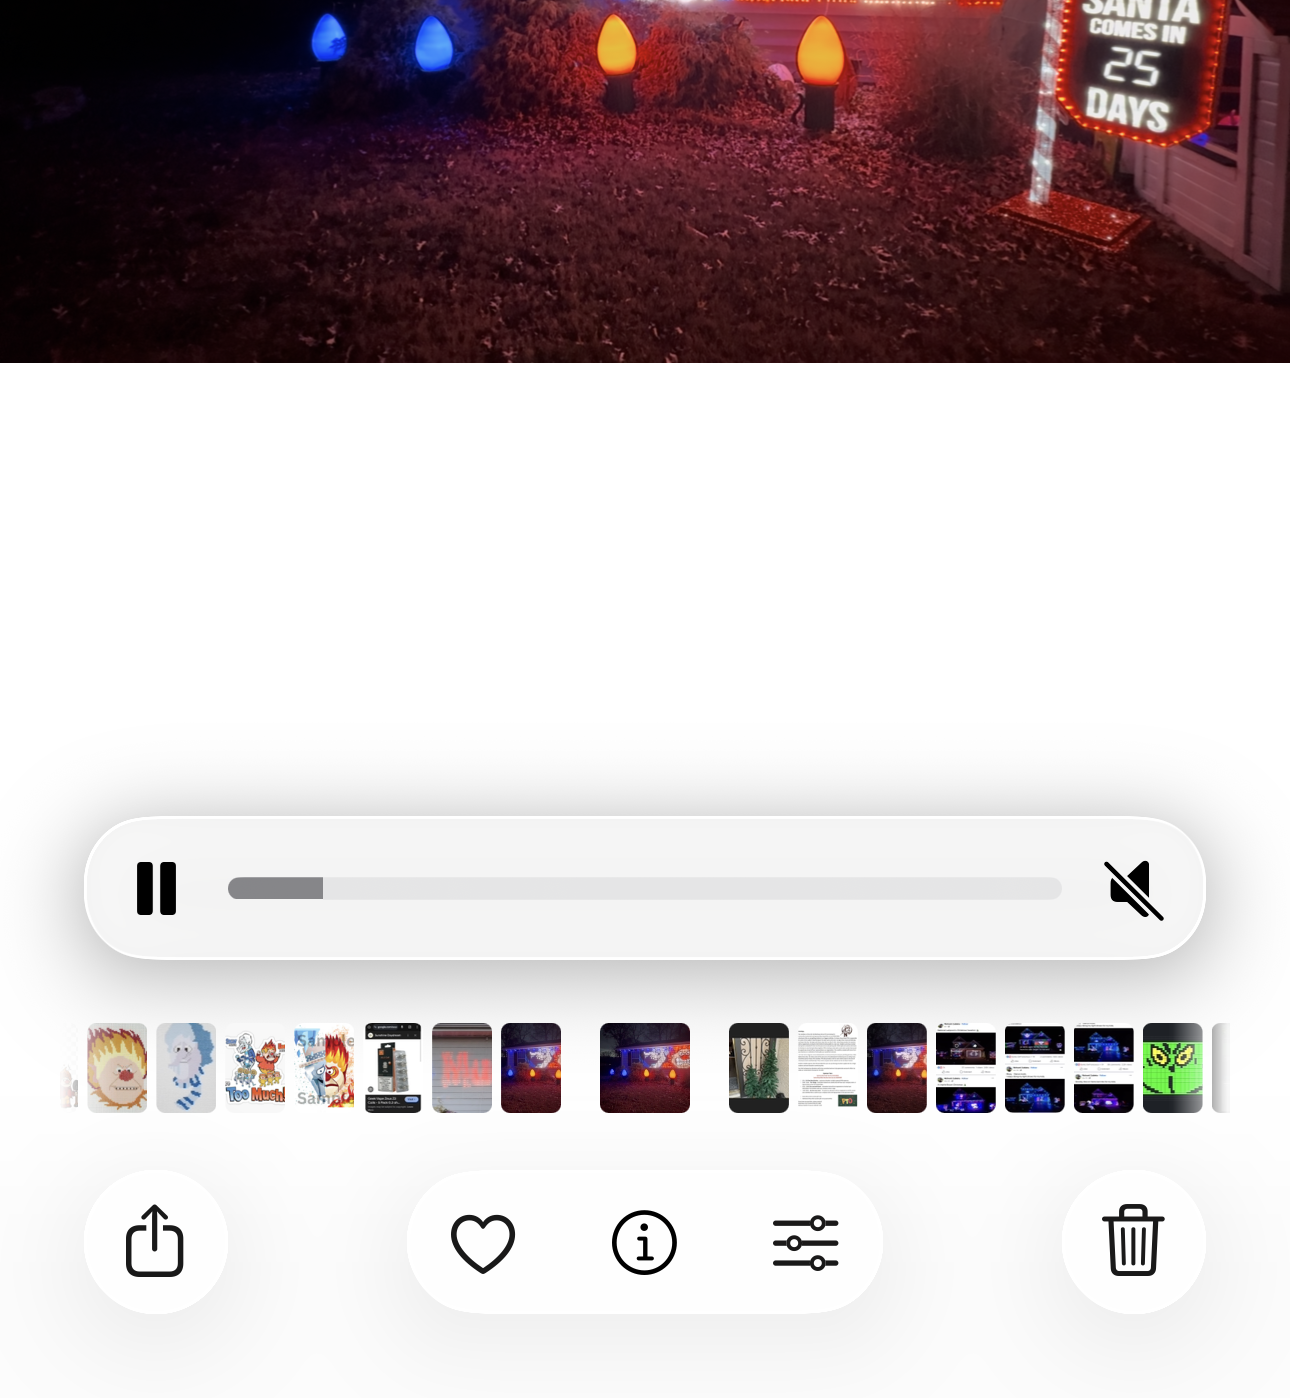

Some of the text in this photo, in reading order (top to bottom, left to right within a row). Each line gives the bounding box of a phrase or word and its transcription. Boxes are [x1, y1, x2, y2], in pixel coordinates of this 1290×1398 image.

[1089, 17, 1188, 45] COMES IN
[1103, 46, 1161, 87] 25
[1085, 86, 1170, 133] DAYS
[225, 1086, 250, 1103] Too
